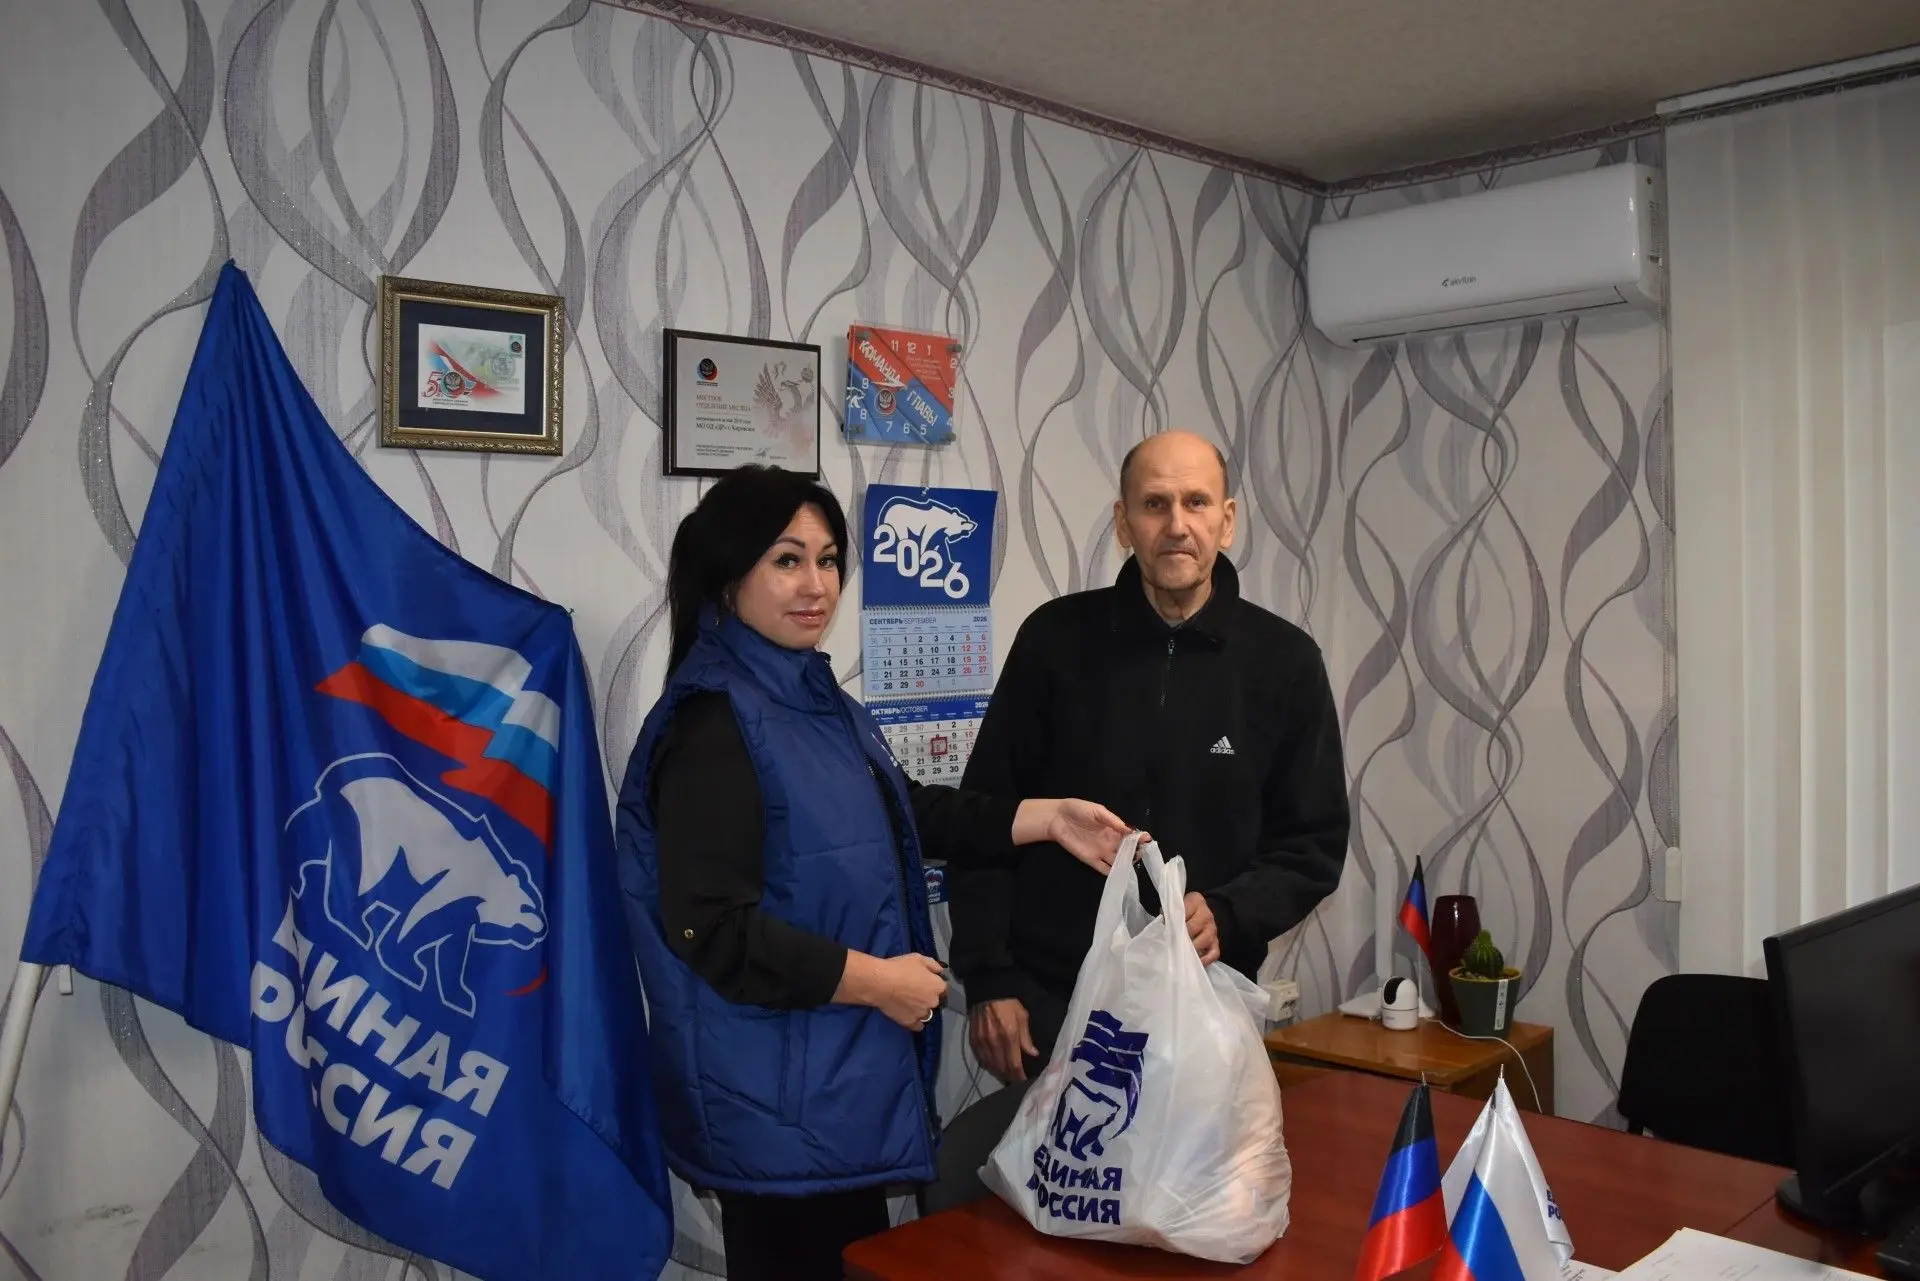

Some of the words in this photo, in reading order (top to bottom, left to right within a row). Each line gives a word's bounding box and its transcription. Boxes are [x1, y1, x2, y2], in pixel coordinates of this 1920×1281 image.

[891, 340, 898, 352] 11
[907, 341, 916, 354] 12
[927, 345, 931, 356] 1
[950, 358, 957, 369] 2
[862, 378, 869, 389] 9
[860, 408, 867, 420] 8
[886, 421, 893, 433] 7
[903, 423, 910, 434] 6
[921, 424, 927, 435] 5
[946, 416, 953, 428] 4
[873, 523, 969, 599] 2026
[1210, 747, 1235, 755] adidas
[272, 930, 510, 1118] ИНАЯ
